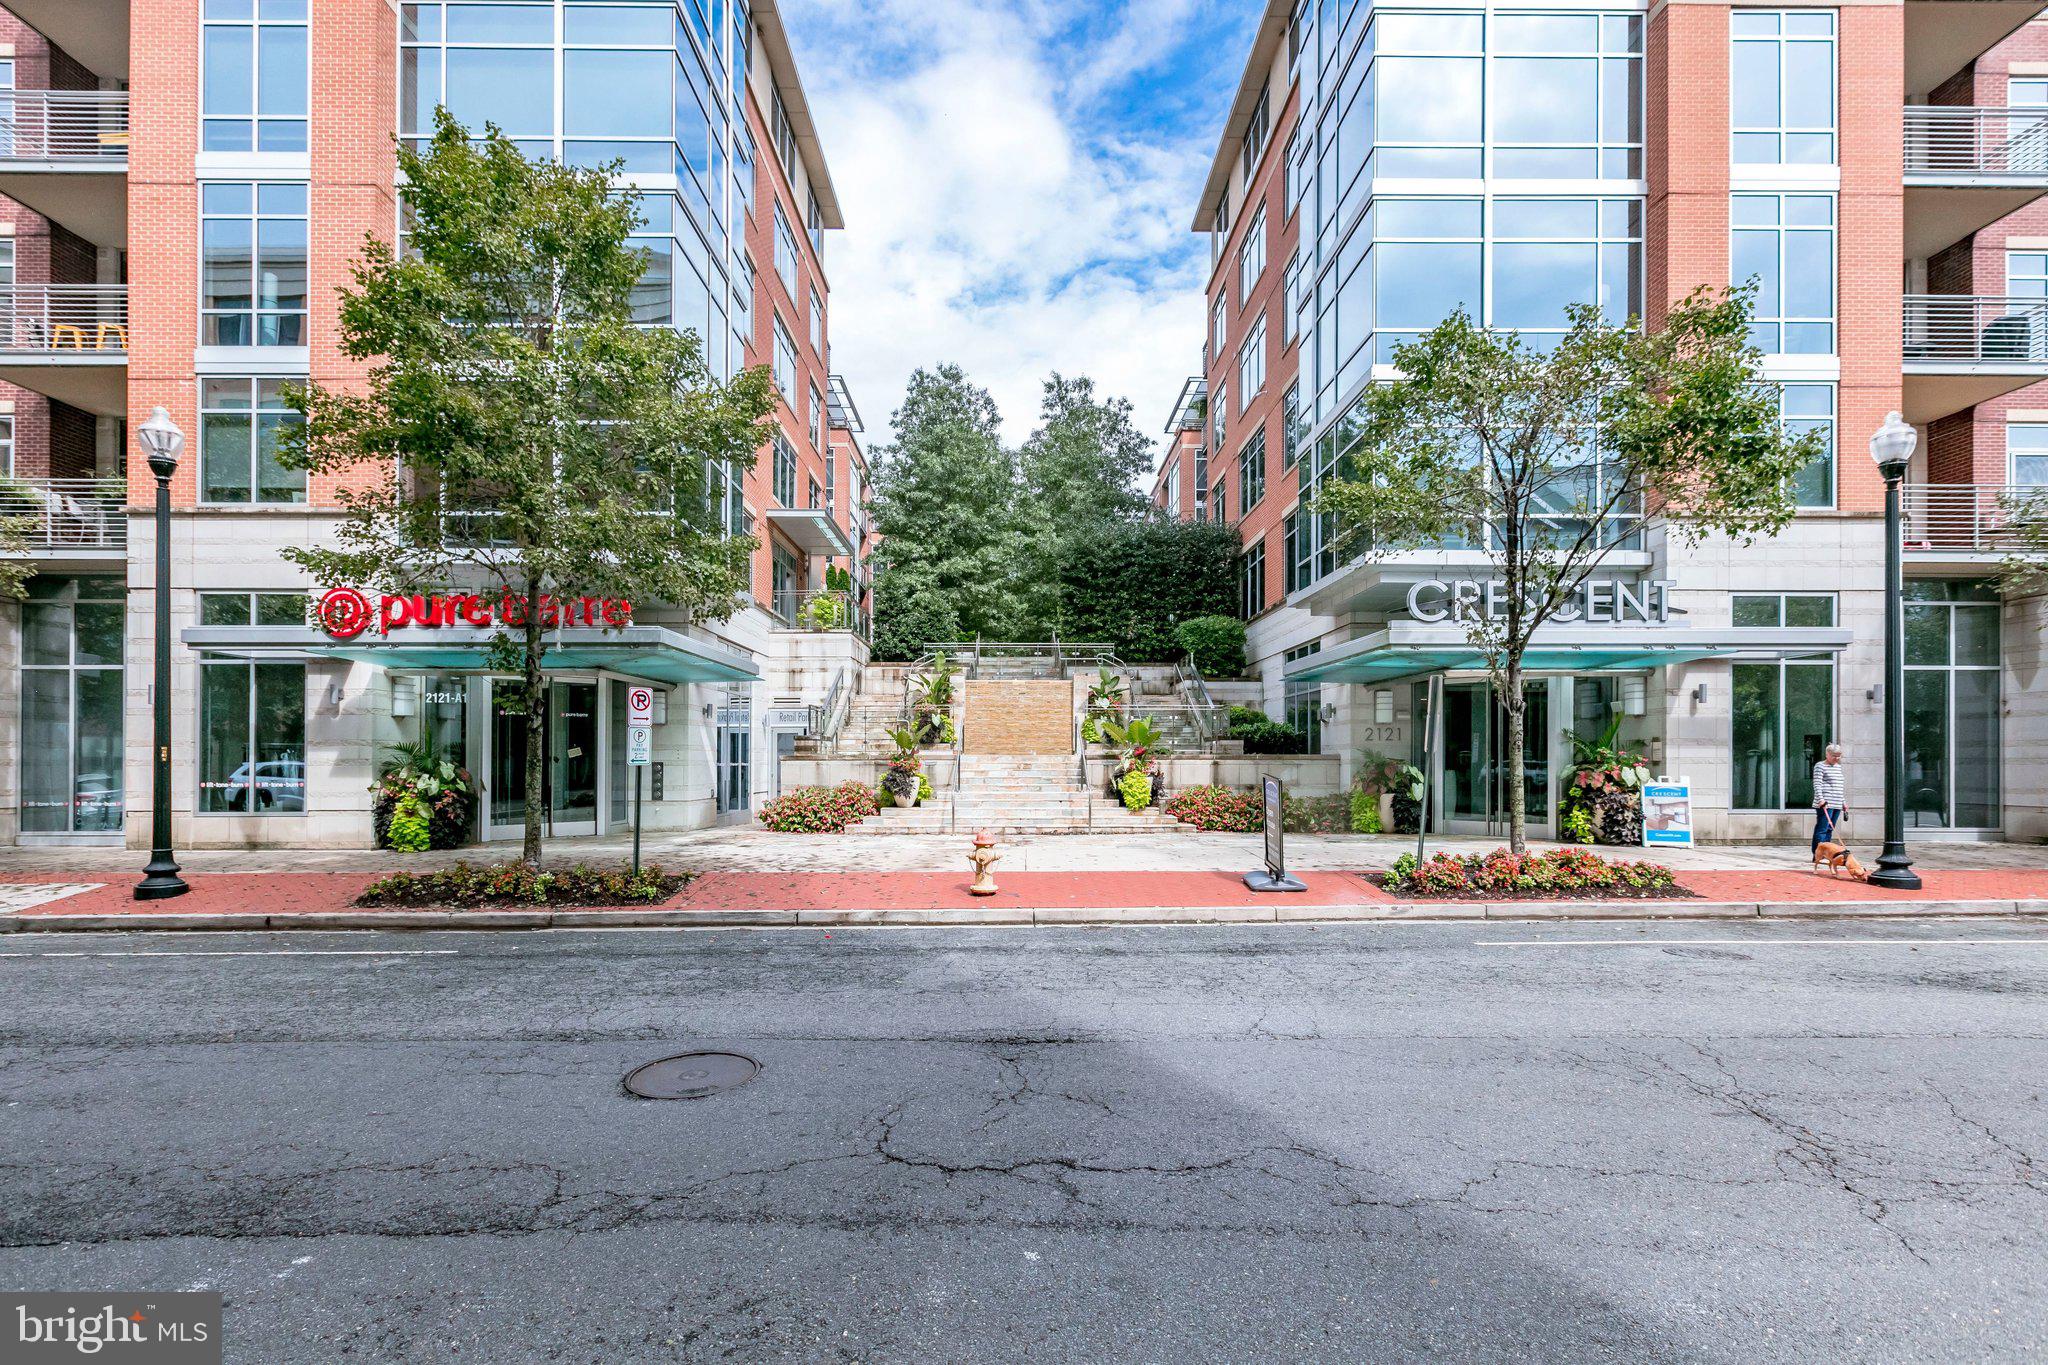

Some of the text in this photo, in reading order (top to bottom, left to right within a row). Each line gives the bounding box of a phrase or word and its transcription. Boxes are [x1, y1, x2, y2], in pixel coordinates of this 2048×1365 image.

[1407, 580, 1676, 622] CRESCENT
[381, 594, 492, 635] pure
[425, 692, 467, 704] 2121-A1
[779, 712, 796, 722] Retail
[1364, 727, 1402, 741] 2121
